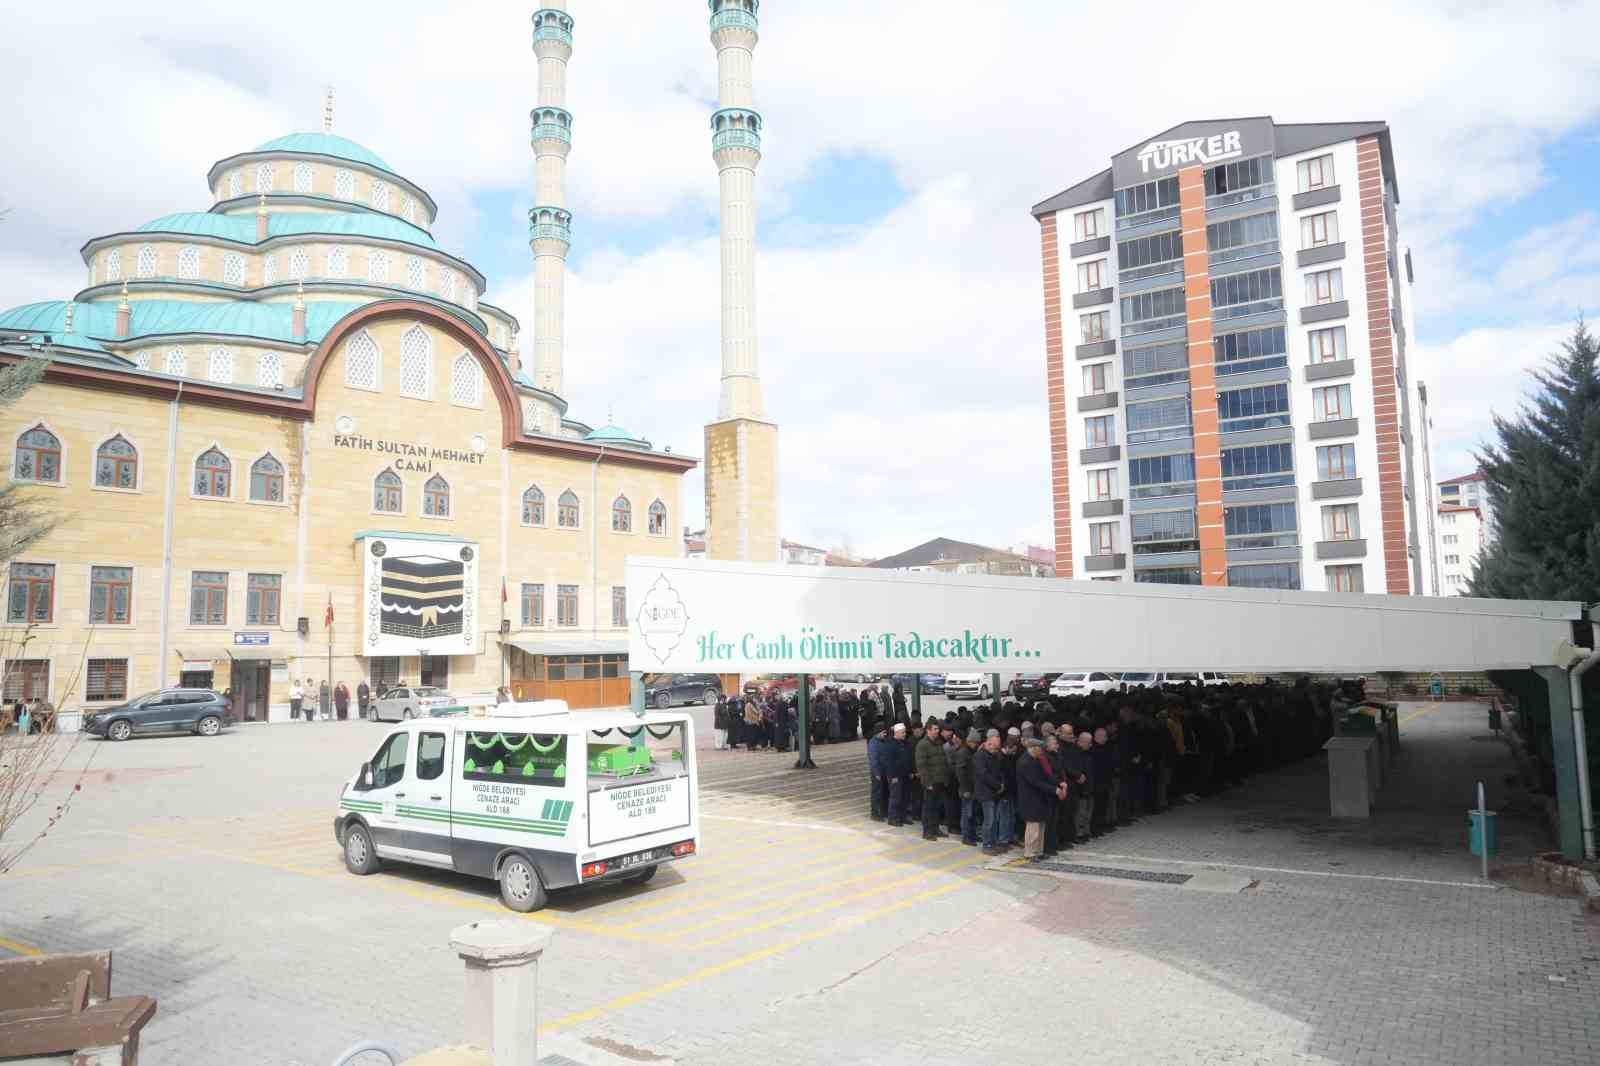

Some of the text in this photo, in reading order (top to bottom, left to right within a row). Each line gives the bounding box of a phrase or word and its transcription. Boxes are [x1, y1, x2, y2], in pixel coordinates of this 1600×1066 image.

[1137, 130, 1242, 173] TÜRKER
[334, 433, 485, 465] FATİH SULTAN MEHMET
[395, 458, 432, 473] CAMİ
[696, 630, 735, 664] Her
[742, 632, 793, 662] Canlı
[800, 627, 873, 661] Ölümü
[476, 793, 500, 804] CENAZE
[617, 798, 644, 810] CENAZE
